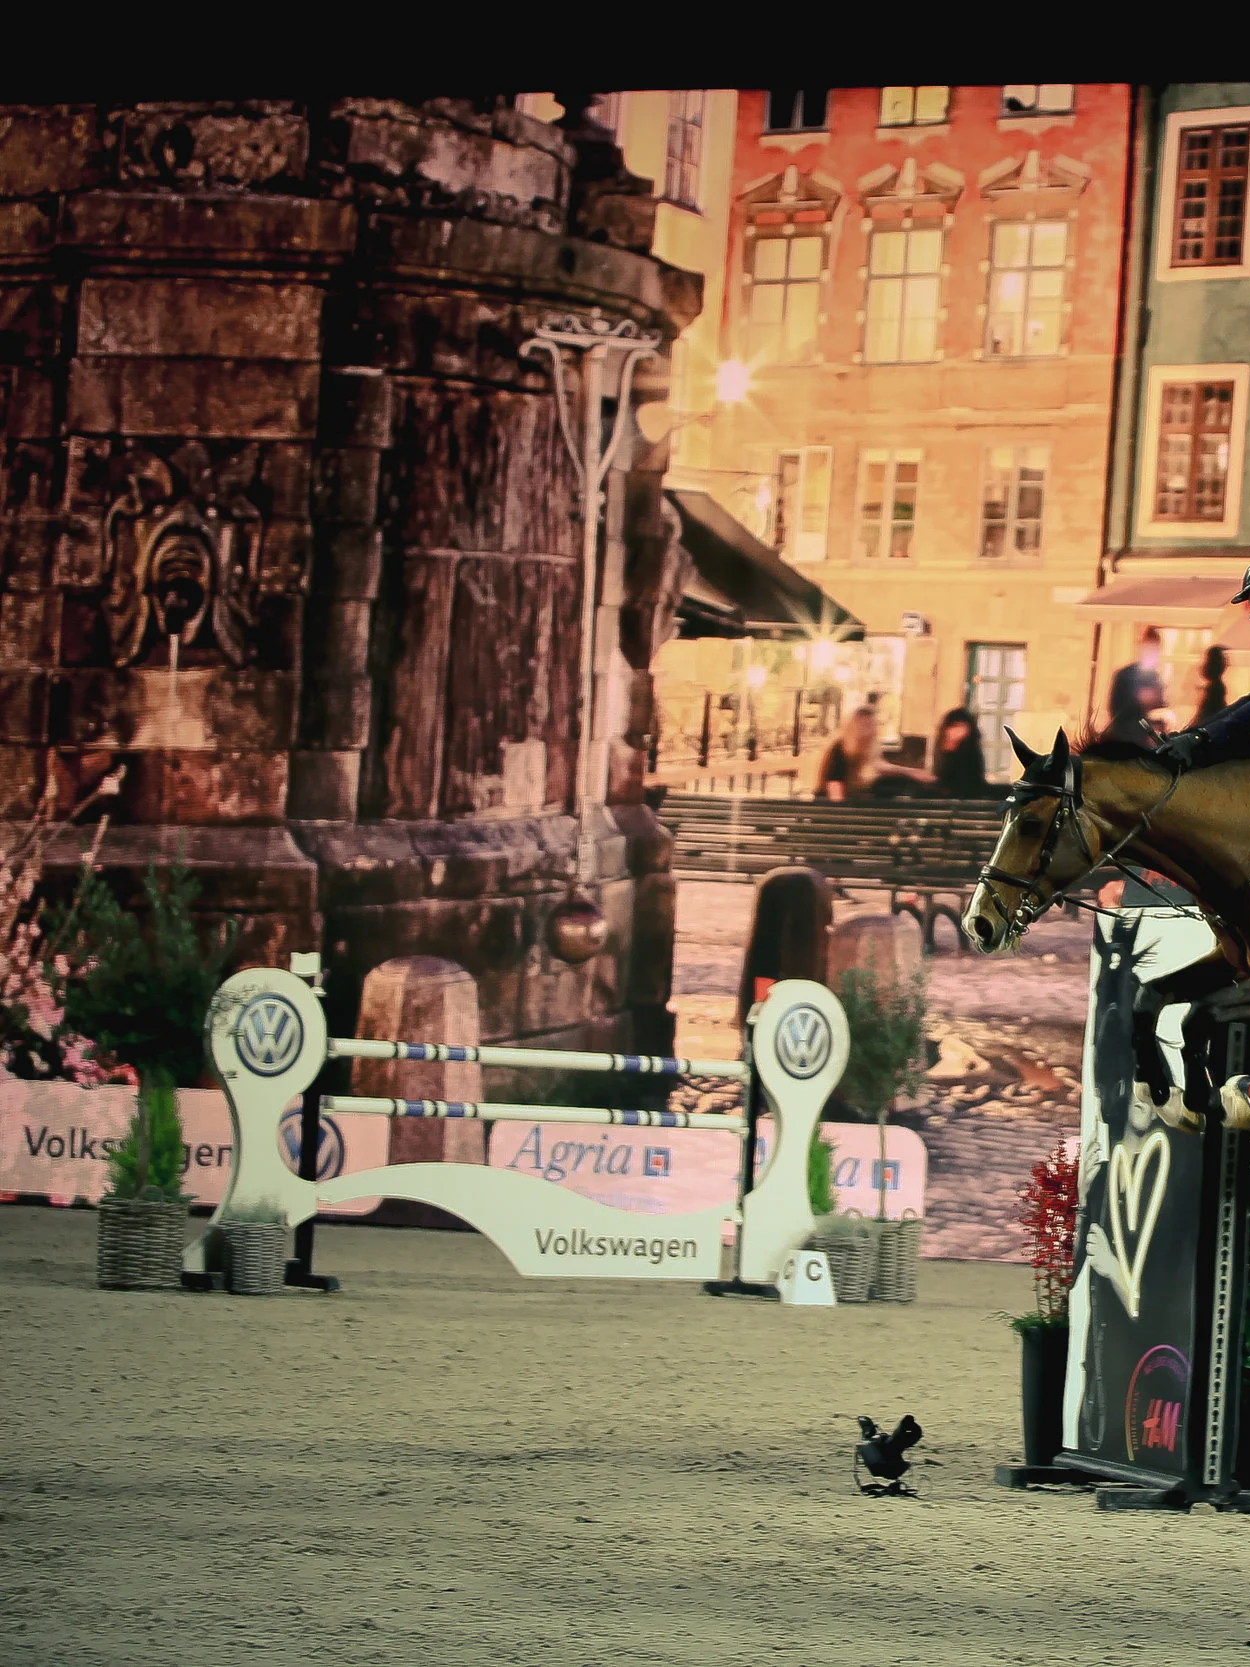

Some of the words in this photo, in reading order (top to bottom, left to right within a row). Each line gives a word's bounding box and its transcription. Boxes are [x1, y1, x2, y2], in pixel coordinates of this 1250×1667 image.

[25, 1124, 232, 1175] Volksgen
[509, 1125, 633, 1182] Agria
[535, 1227, 697, 1264] Volkswagen
[805, 1259, 822, 1281] C
